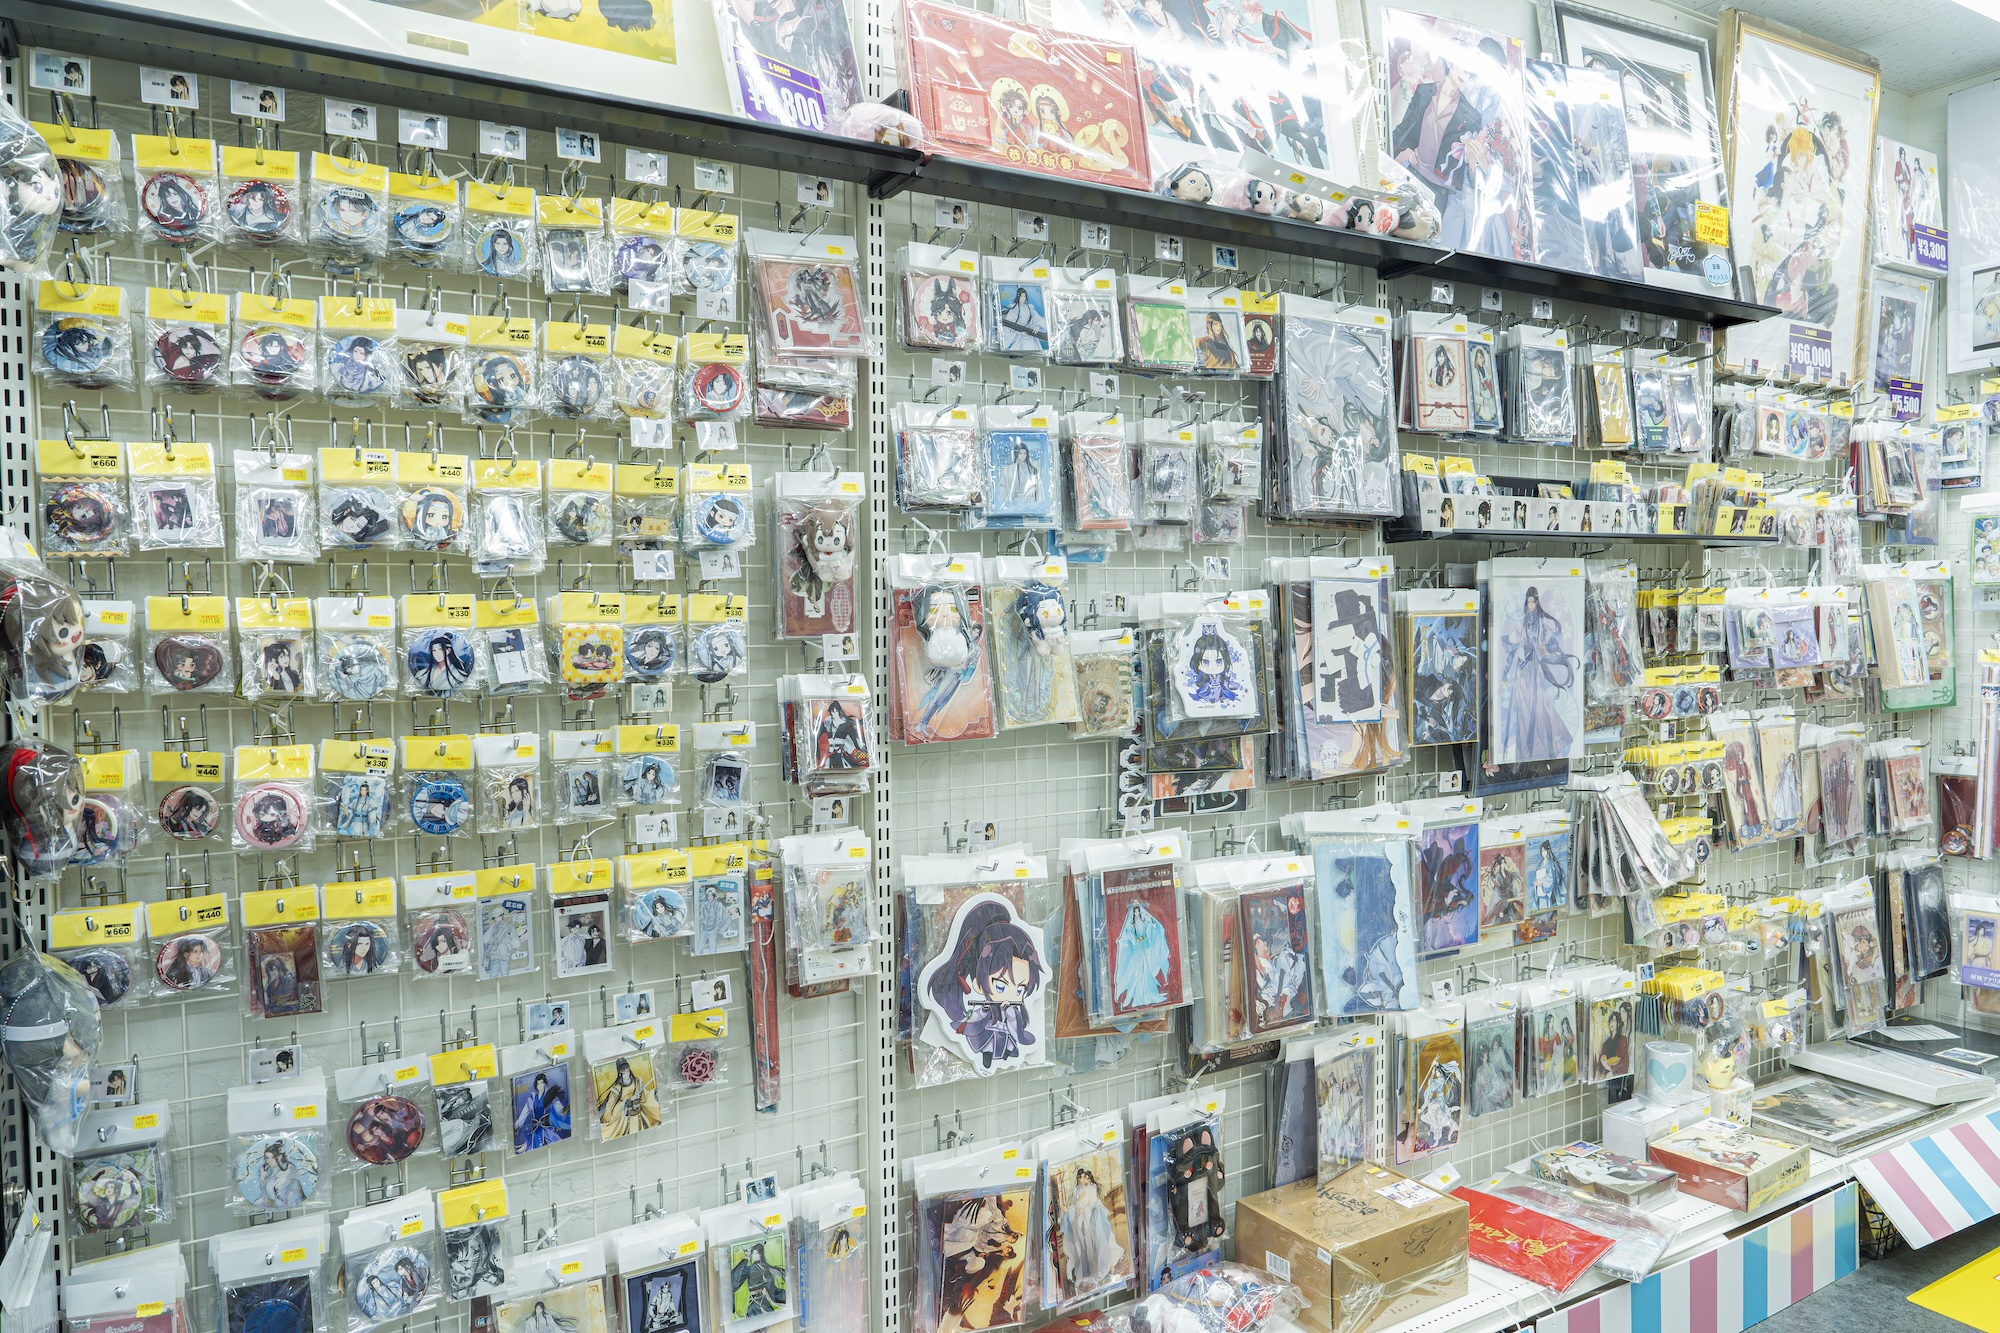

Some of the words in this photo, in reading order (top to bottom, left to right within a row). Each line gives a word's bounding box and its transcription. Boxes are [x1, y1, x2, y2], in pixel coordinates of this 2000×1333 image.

[1007, 147, 1073, 170] 恭贺新春
[1917, 238, 1946, 262] ¥3,300
[510, 333, 529, 341] ¥440
[586, 339, 605, 347] ¥440
[1790, 343, 1831, 368] ¥66,000
[92, 459, 116, 468] ¥660
[368, 465, 389, 473] ¥660
[440, 469, 461, 477] ¥440
[655, 480, 673, 488] ¥330
[729, 477, 747, 485] ¥220
[600, 606, 619, 614] ¥660
[725, 608, 742, 616] ¥330
[656, 738, 674, 746] ¥330
[366, 759, 387, 767] ¥330
[197, 768, 218, 776] ¥440
[667, 869, 686, 877] ¥330
[198, 910, 222, 920] ¥440
[105, 927, 130, 936] ¥660
